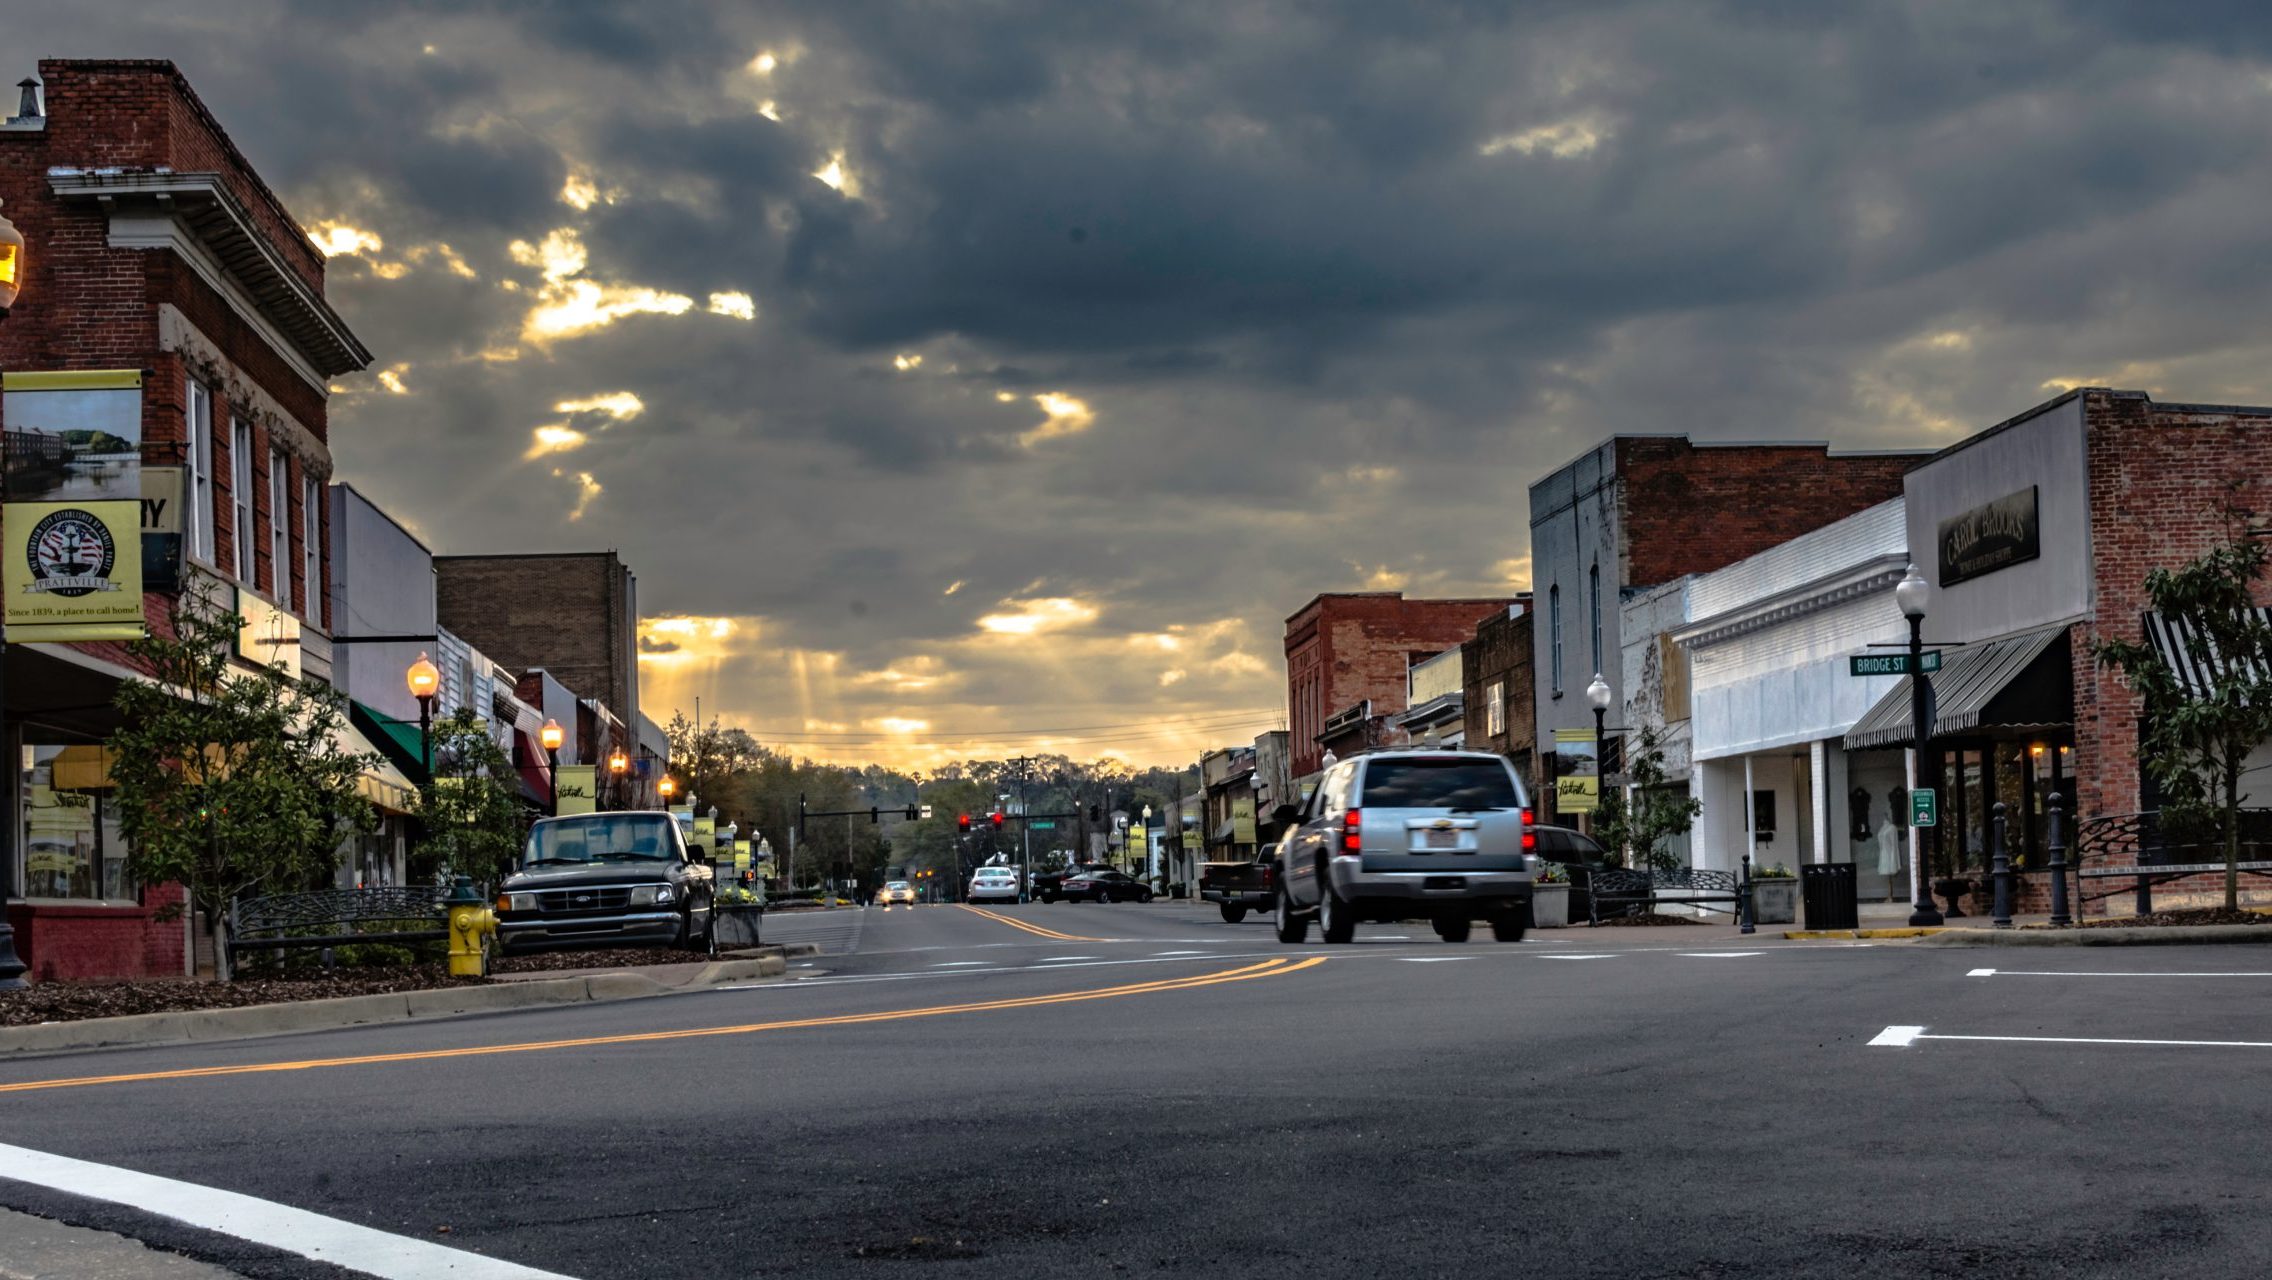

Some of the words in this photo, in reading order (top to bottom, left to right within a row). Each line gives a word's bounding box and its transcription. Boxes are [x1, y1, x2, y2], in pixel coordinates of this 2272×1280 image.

[55, 511, 94, 521] ESTABLISHED
[1948, 516, 1978, 566] CAROL
[1982, 507, 2024, 542] BROOKS
[39, 578, 106, 588] PRATTVILLE
[8, 608, 30, 617] Since
[32, 608, 55, 617] 1839,
[63, 607, 84, 618] place
[86, 608, 95, 616] to
[96, 606, 111, 615] call
[112, 604, 139, 615] home!
[1857, 658, 1891, 673] BRIDGE
[1893, 657, 1904, 671] ST
